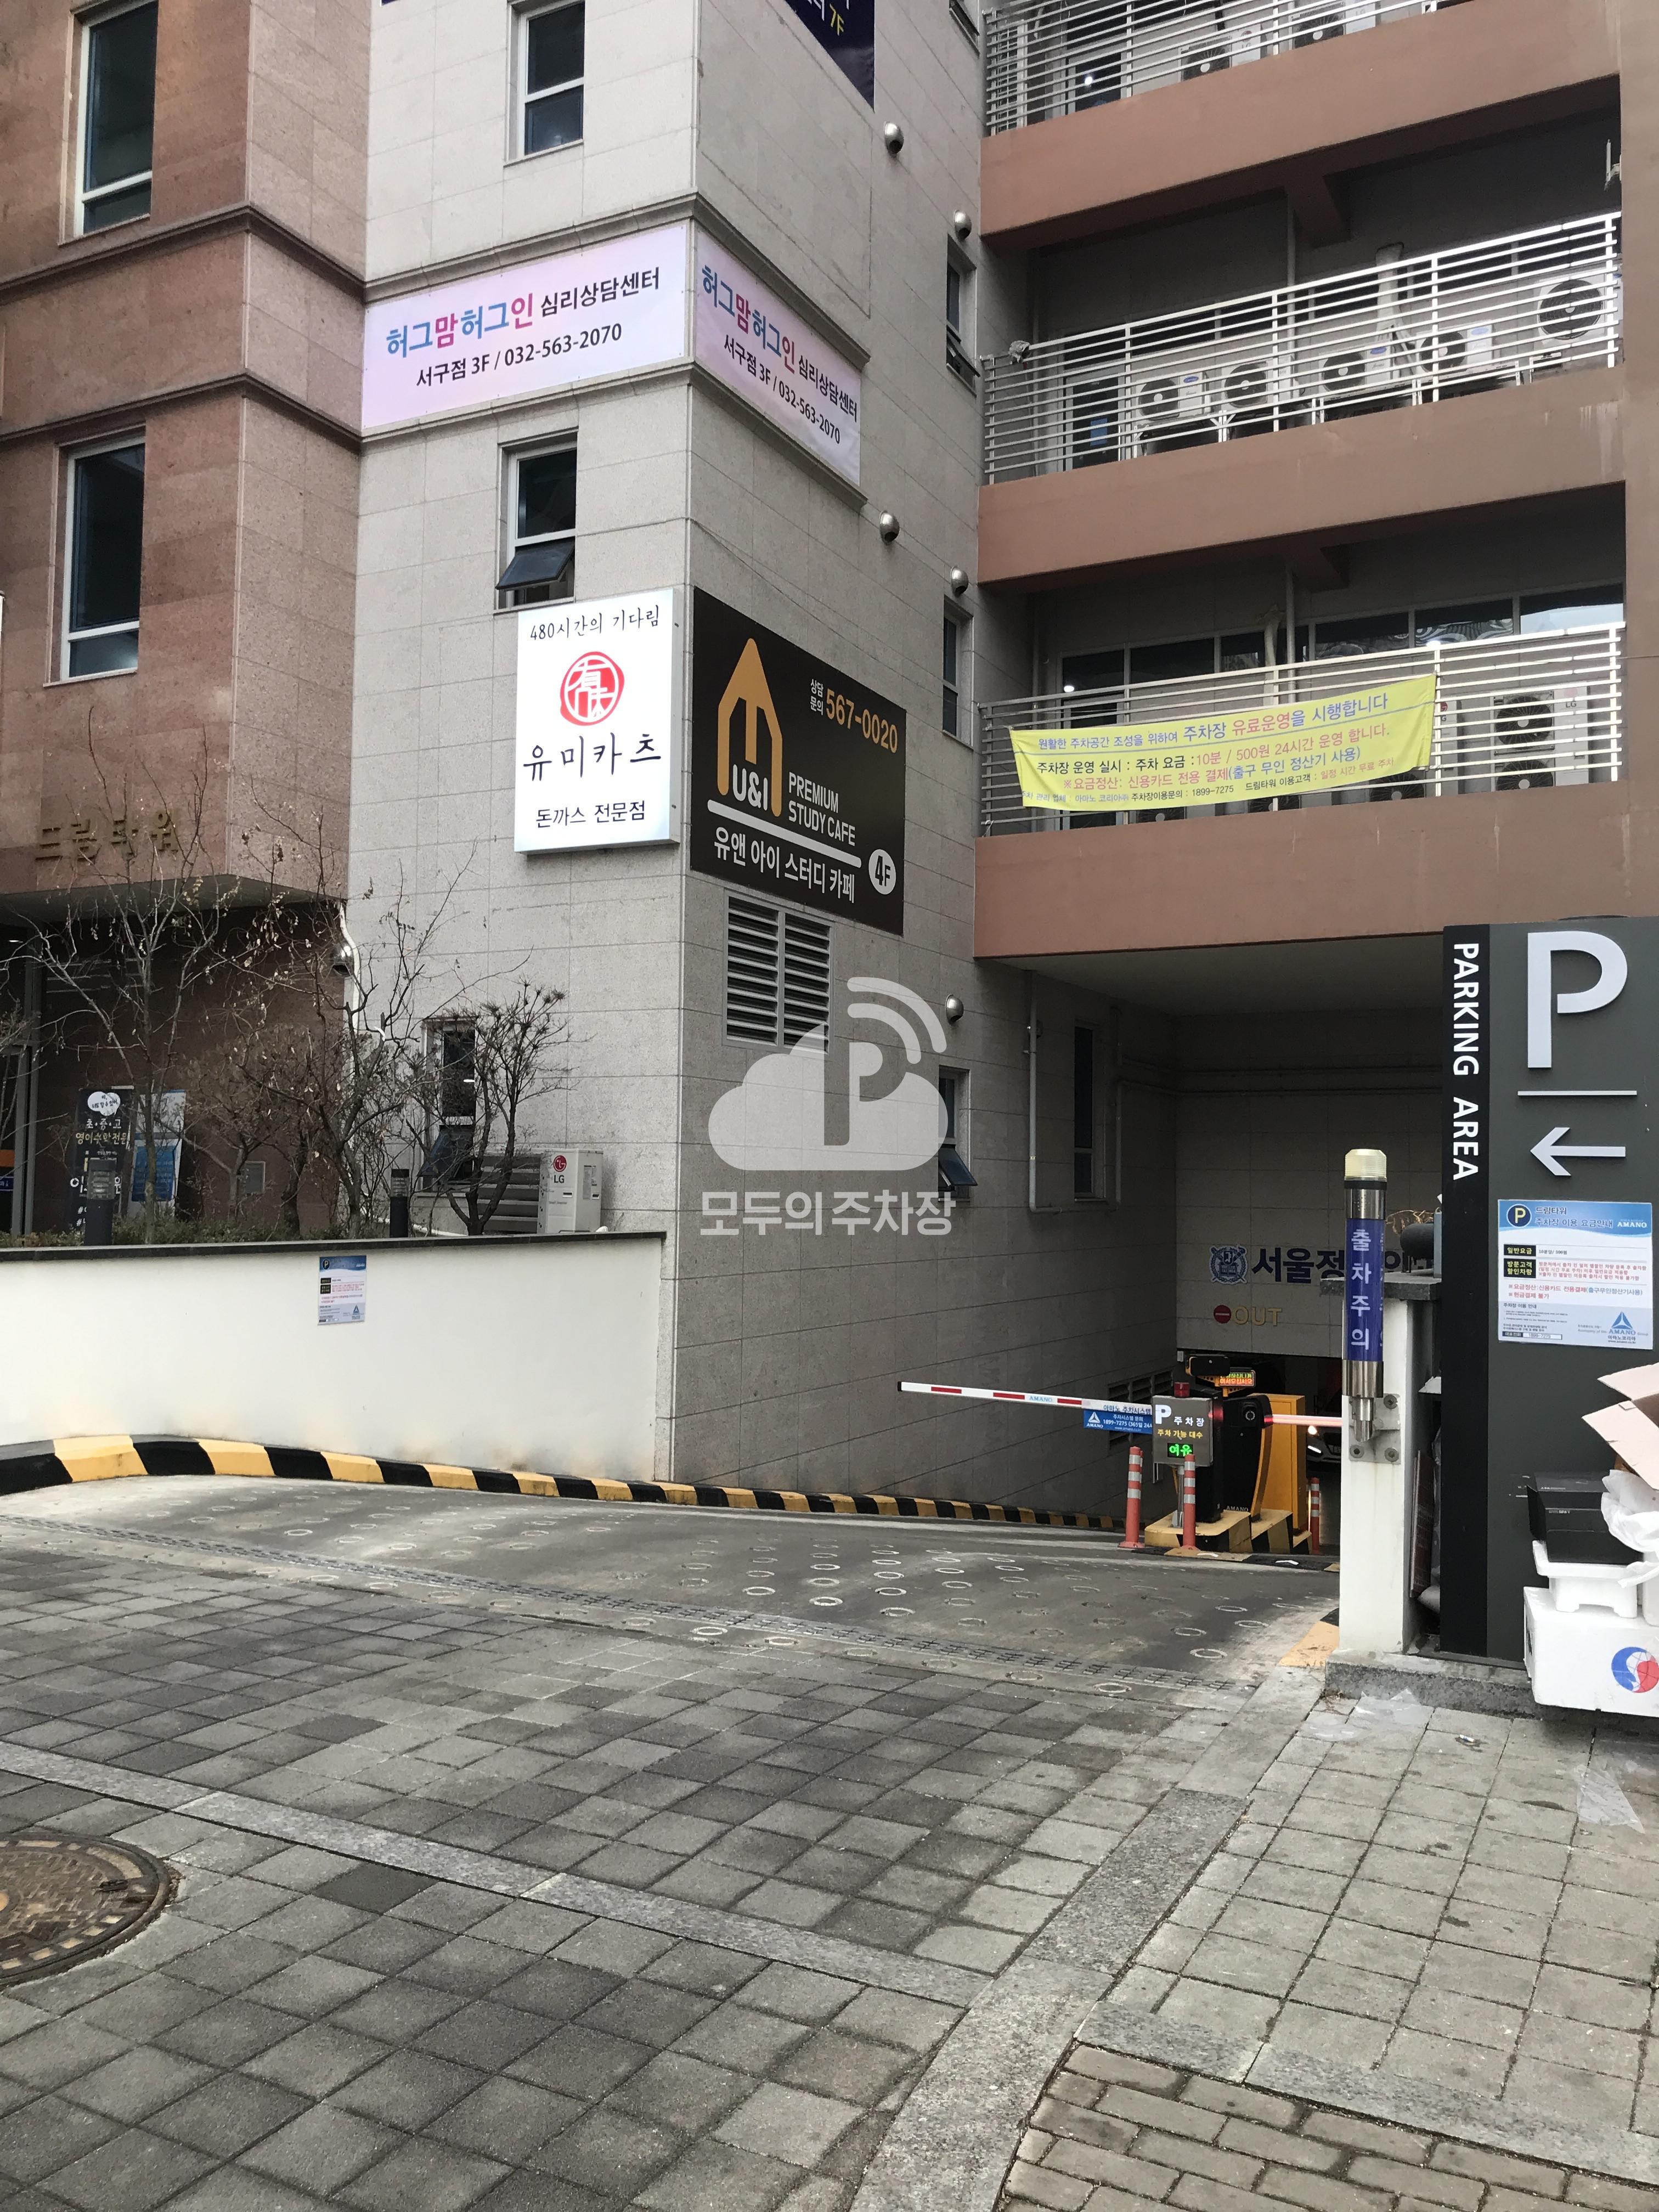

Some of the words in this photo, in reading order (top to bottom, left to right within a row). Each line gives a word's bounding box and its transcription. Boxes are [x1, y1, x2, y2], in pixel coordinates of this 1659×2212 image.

[830, 4, 844, 36] 7F
[386, 293, 533, 358] 허그맘허그인
[540, 267, 661, 318] 심리상담센터
[416, 358, 466, 388] 서구점
[471, 354, 490, 375] 3F
[504, 322, 622, 367] 032-563-2070
[702, 264, 795, 374] 허그맘허그인
[799, 354, 858, 423] 심리상담센터
[724, 334, 757, 377] 서구점
[759, 363, 771, 385] 3F
[778, 381, 840, 444] 032-563-2070
[530, 612, 603, 641] 480시간의
[612, 604, 659, 632] 기다림
[809, 696, 823, 716] 문의
[810, 678, 823, 698] 상담
[826, 688, 898, 754] 567-0020
[1038, 738, 1066, 750] 원활한
[1070, 737, 1109, 749] 주차공간
[1113, 734, 1143, 747] 조성을
[1148, 731, 1178, 745] 위하여
[1183, 722, 1227, 742] 주차장
[1232, 710, 1305, 736] 유료운영을
[1312, 693, 1388, 722] 시행합니다
[523, 731, 662, 782] 유미카츠
[1036, 761, 1069, 775] 주차장
[1073, 761, 1094, 774] 운영
[1099, 759, 1121, 774] 실시
[1136, 757, 1159, 771] 주차
[1163, 755, 1186, 769] 요금
[1236, 744, 1269, 761] 500원
[1275, 737, 1314, 755] 24시간
[1319, 731, 1343, 748] 운영
[1348, 723, 1390, 743] 합니다.
[1128, 774, 1173, 789] 신용카드
[1178, 770, 1200, 786] 전용
[1205, 764, 1256, 782] 결제(출구
[1261, 760, 1285, 775] 무인
[1290, 752, 1326, 771] 정산기
[1331, 746, 1361, 763] 사용)
[732, 763, 768, 812] U&I
[789, 771, 839, 814] PREMIUM
[1052, 793, 1066, 803] 업체
[1075, 794, 1096, 803] 아마노
[1131, 789, 1183, 802] 주차장이용문의
[1192, 785, 1234, 797] 1899-7275
[1245, 778, 1276, 791] 드림타워
[1279, 773, 1311, 786] 이용고객
[1321, 769, 1337, 780] 일정
[1340, 766, 1356, 777] 시간
[1359, 763, 1375, 773] 무료
[1378, 757, 1395, 769] 주차
[535, 806, 586, 828] 돈까스
[594, 800, 646, 824] 전문점
[788, 804, 825, 836] STUDY
[827, 819, 856, 847] CAFE
[714, 826, 746, 867] 유앤
[751, 840, 780, 879] 아이
[785, 852, 825, 894] 스터디
[829, 868, 855, 904] 카페
[874, 855, 891, 888] 4F
[1453, 943, 1480, 1076] PARKING
[1527, 930, 1628, 1069] P
[1453, 1096, 1480, 1181] AREA
[554, 1175, 565, 1184] LG
[1536, 1206, 1567, 1215] 드림타워
[1536, 1218, 1559, 1227] 주차장
[1562, 1218, 1578, 1227] 이용
[1581, 1220, 1613, 1228] 요금안내
[1351, 1228, 1372, 1351] 출차주의
[1233, 1305, 1283, 1327] OUT
[1029, 1395, 1053, 1403] AMANO
[1103, 1404, 1121, 1413] 아마노
[1155, 1404, 1172, 1425] P
[1157, 1429, 1171, 1437] 주차
[1173, 1430, 1187, 1438] 가능
[1189, 1430, 1203, 1439] 대수
[1173, 1416, 1205, 1427] 주차장
[1169, 1443, 1193, 1457] 여유
